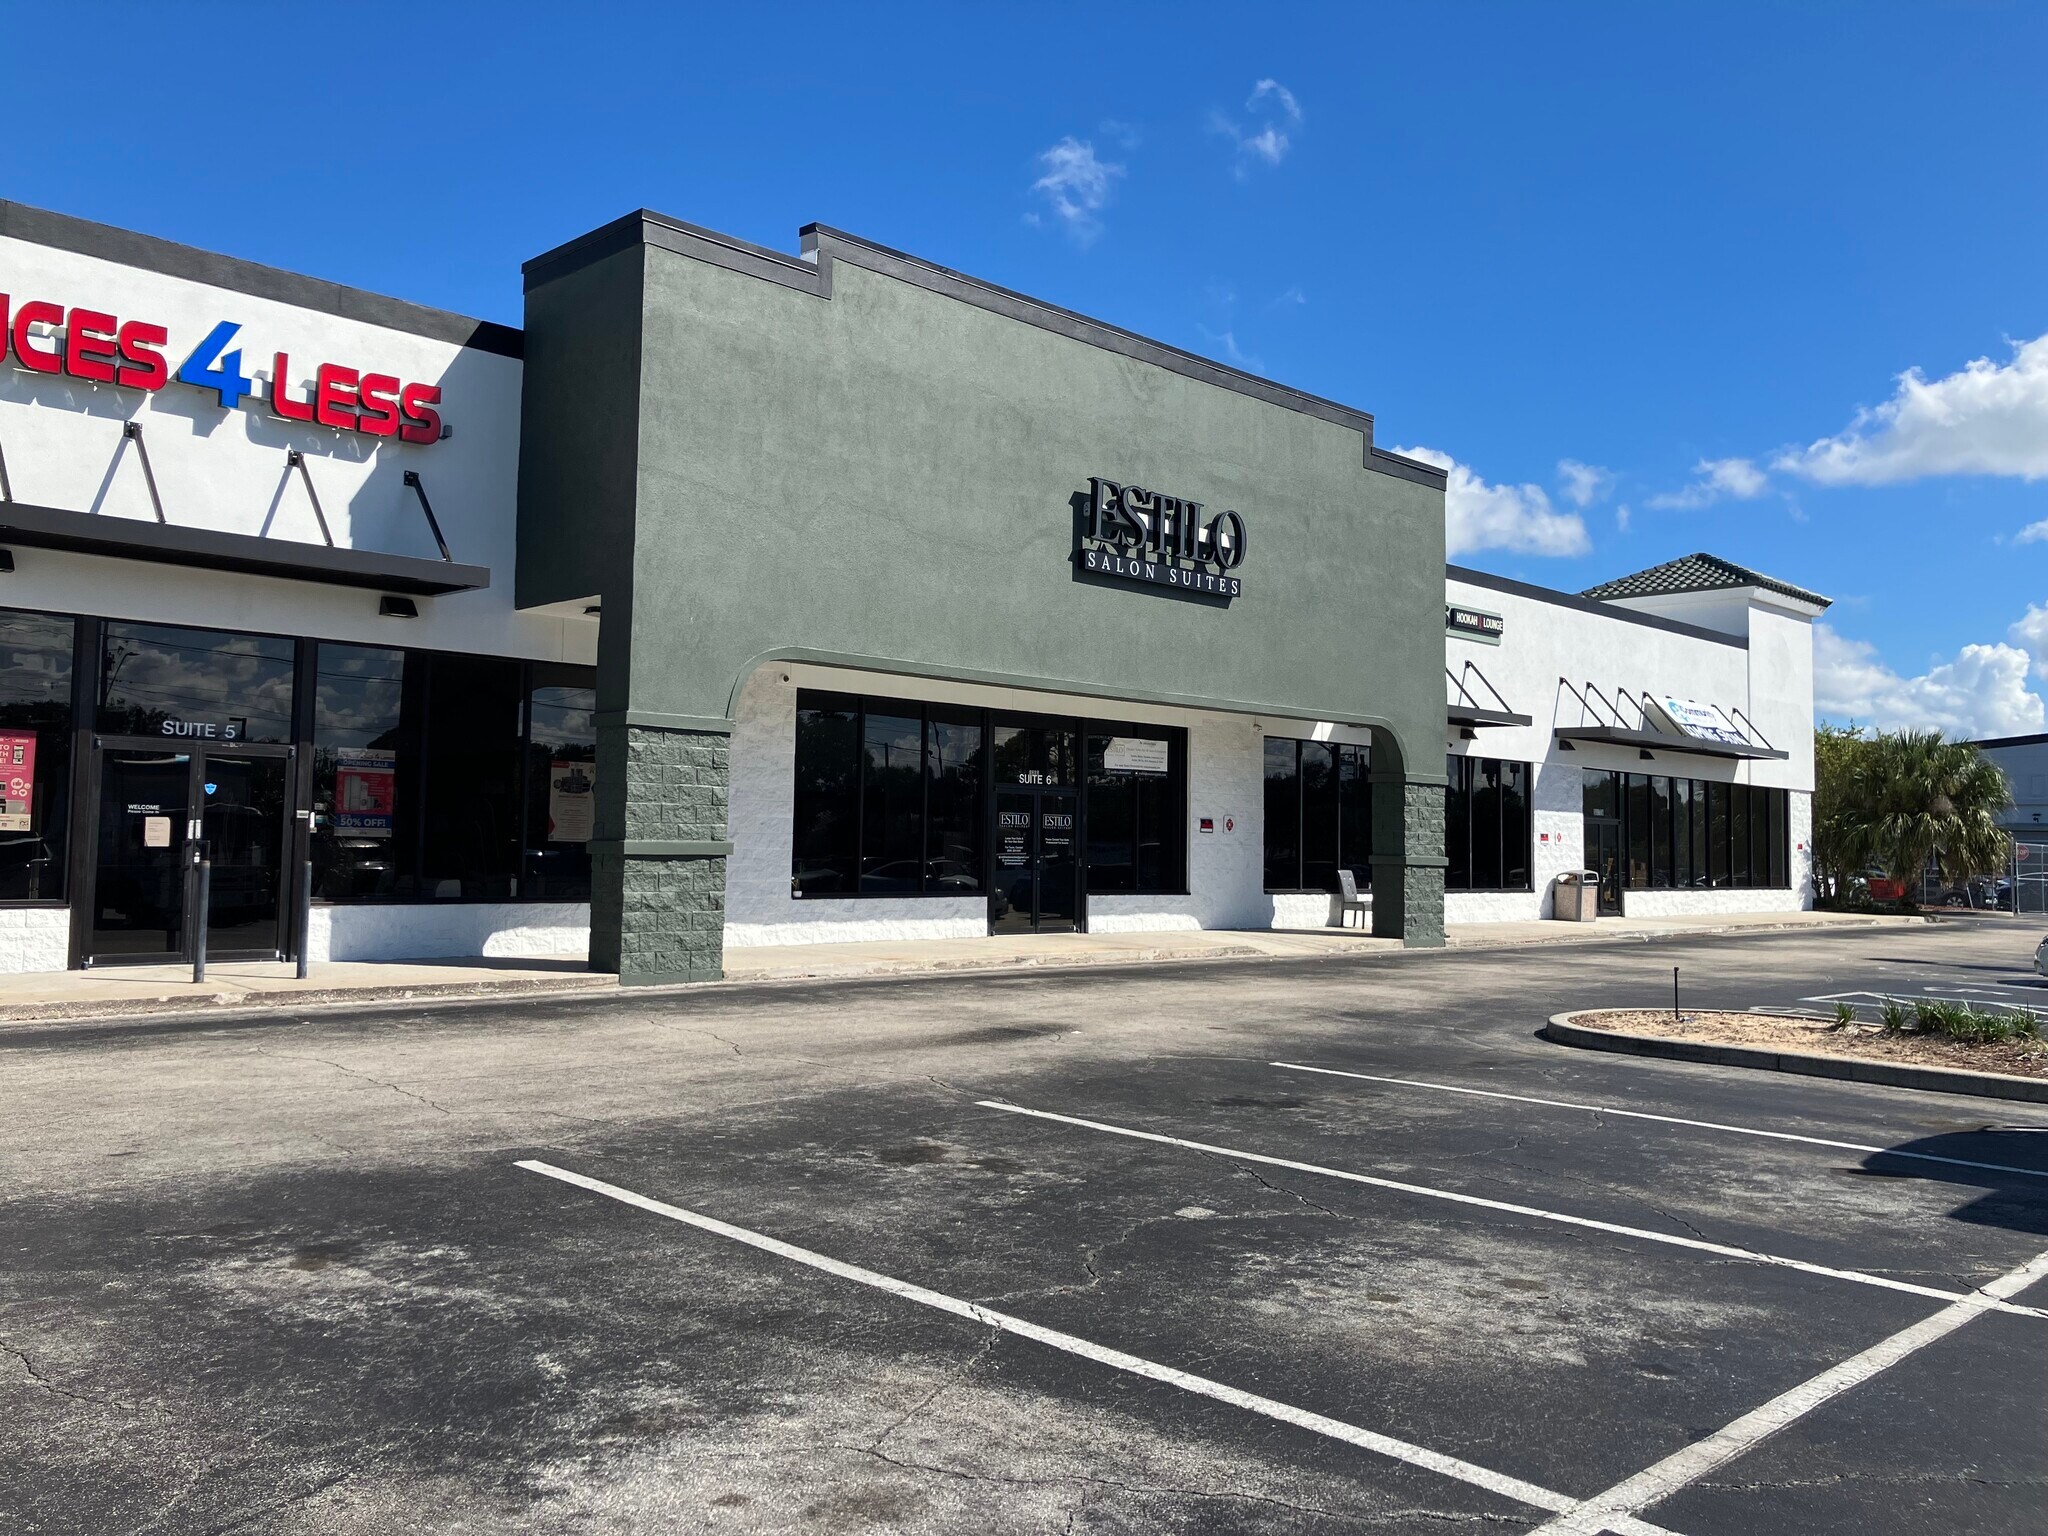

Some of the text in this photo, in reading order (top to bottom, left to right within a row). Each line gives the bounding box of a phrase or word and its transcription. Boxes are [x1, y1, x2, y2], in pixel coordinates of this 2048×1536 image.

[0, 293, 442, 444] CES 4 LESS
[1087, 477, 1247, 569] ESTILO
[1087, 552, 1238, 595] SALON SUITES
[1456, 612, 1478, 626] HOOKAH
[1483, 618, 1502, 630] LOUNGE
[161, 720, 235, 739] SUITE 5
[1018, 774, 1052, 784] SUITE 6
[340, 818, 386, 826] 50% OFF!
[1001, 814, 1028, 825] ESTILO
[1044, 816, 1070, 826] ESTILO
